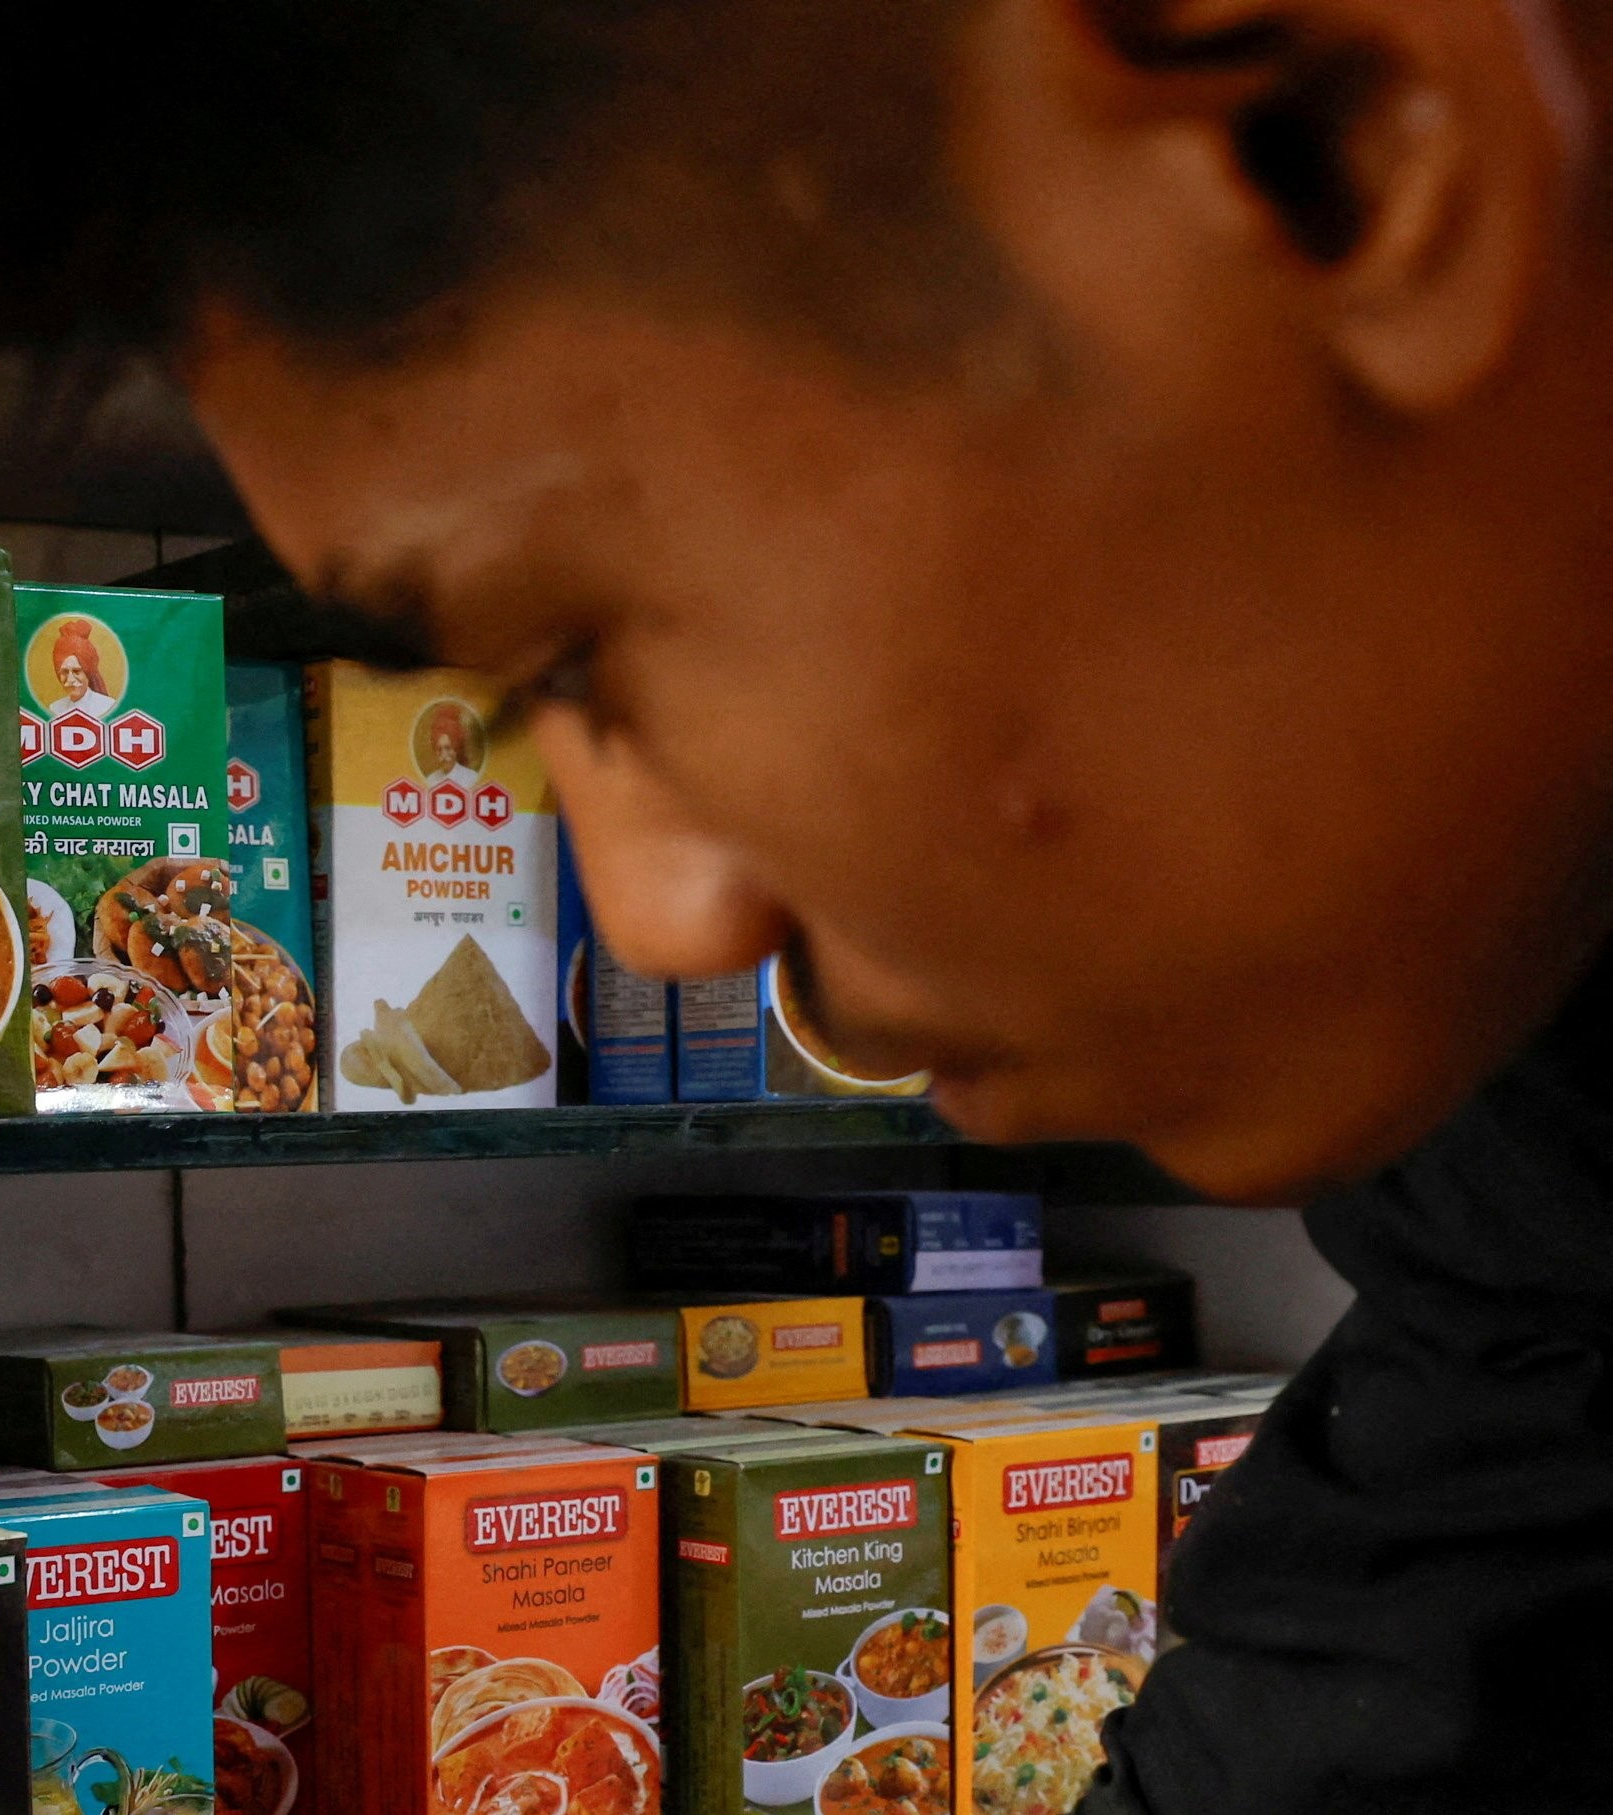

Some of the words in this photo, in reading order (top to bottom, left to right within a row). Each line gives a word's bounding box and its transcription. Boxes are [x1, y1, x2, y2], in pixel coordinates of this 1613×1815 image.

[49, 781, 112, 808] CHAT
[119, 783, 209, 811] MASALA
[389, 791, 508, 818] MDH
[51, 814, 95, 827] MASALA
[96, 816, 142, 828] POWDER
[53, 838, 88, 855] चाट
[91, 839, 155, 857] मसाला
[381, 841, 515, 875] AMCHUR
[406, 878, 491, 900] POWDER
[173, 1378, 258, 1405] EVEREST
[1007, 1459, 1131, 1509] EVEREST
[473, 1495, 620, 1546] EVEREST
[780, 1484, 911, 1535] EVEREST
[1015, 1520, 1063, 1543] Shahi
[1066, 1513, 1121, 1540] Biryani
[680, 1540, 728, 1564] EVEREST
[791, 1545, 860, 1570] Kitchen
[864, 1540, 904, 1563] King
[1037, 1543, 1100, 1569] Masala
[482, 1557, 537, 1584] Shahi
[543, 1553, 613, 1578] Paneer
[814, 1570, 882, 1596] Masala
[512, 1584, 586, 1610] Masala
[39, 1614, 115, 1646] Jaljira
[214, 1621, 256, 1637] Powder
[28, 1648, 128, 1680] Powder
[50, 1684, 97, 1702] Masala
[98, 1679, 145, 1695] Powder
